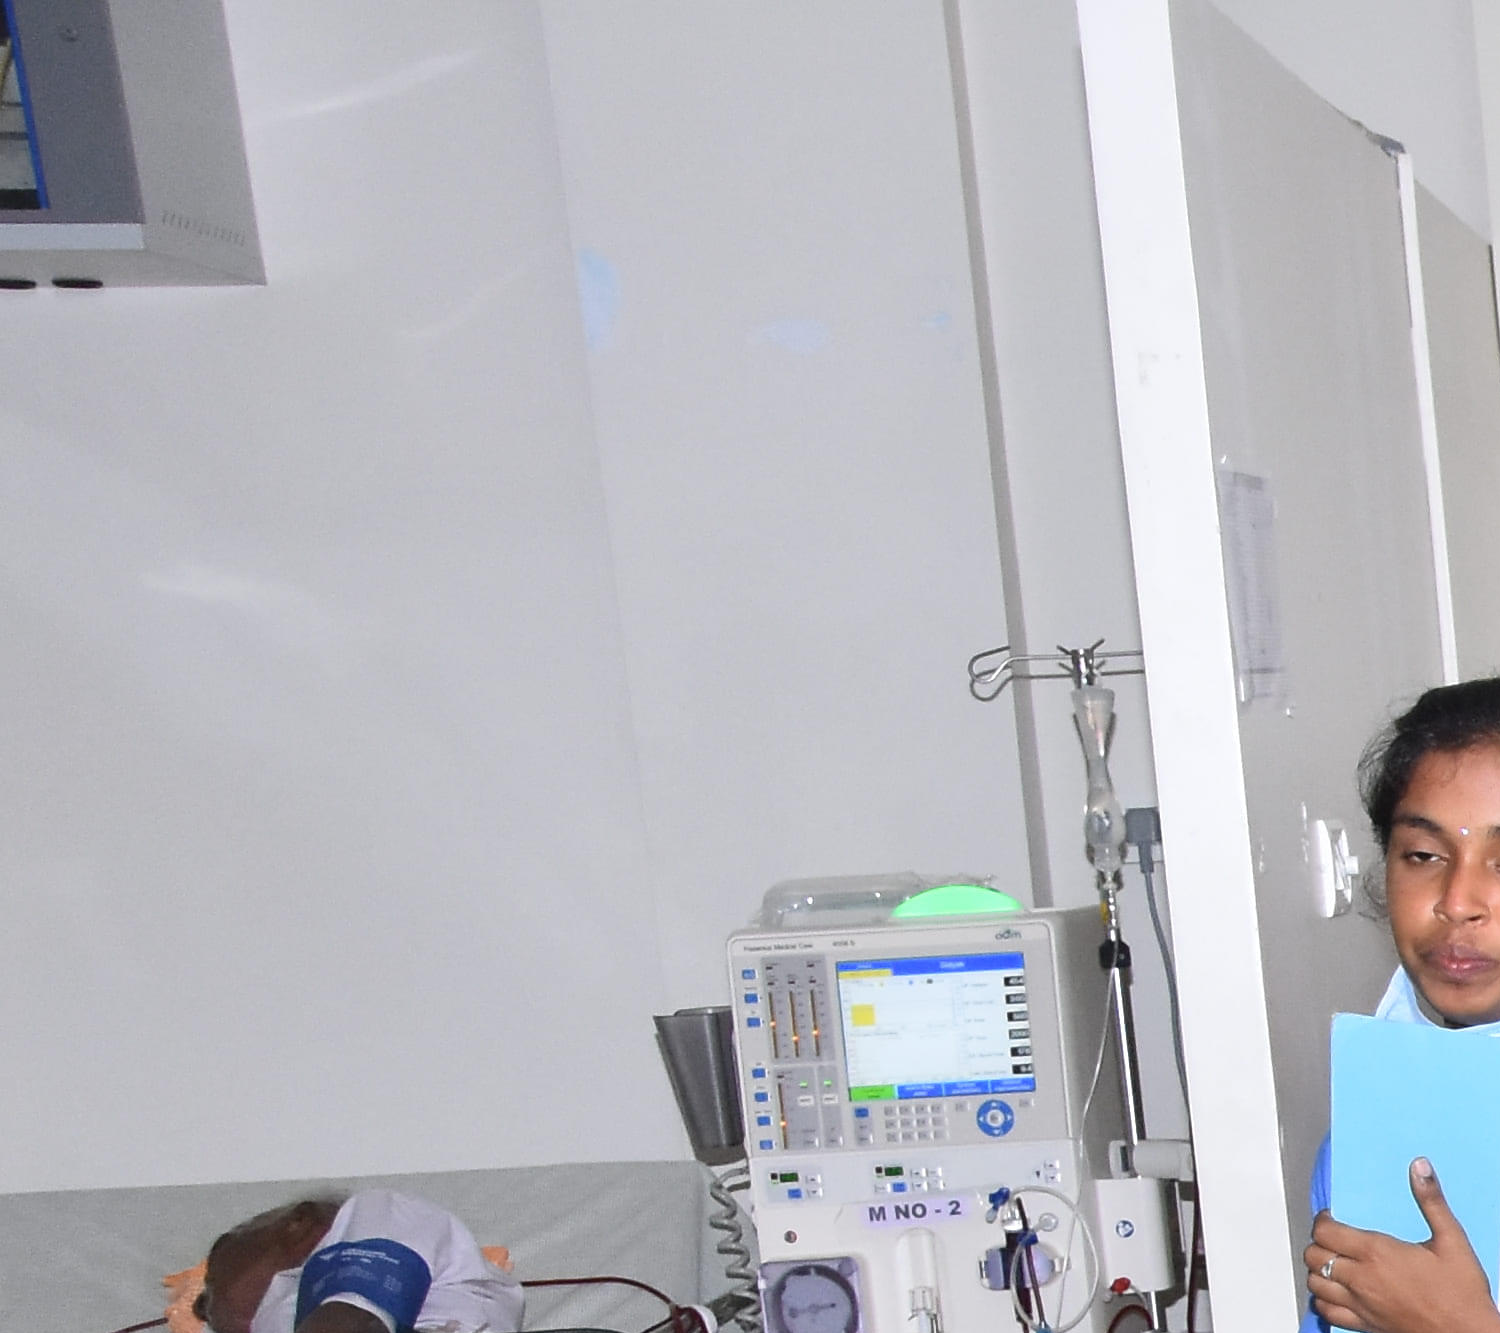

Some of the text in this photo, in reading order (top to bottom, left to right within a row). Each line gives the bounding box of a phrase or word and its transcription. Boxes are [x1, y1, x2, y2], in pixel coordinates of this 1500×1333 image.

[869, 1206, 886, 1221] M
[894, 1203, 927, 1219] NO
[948, 1200, 962, 1216] 2
